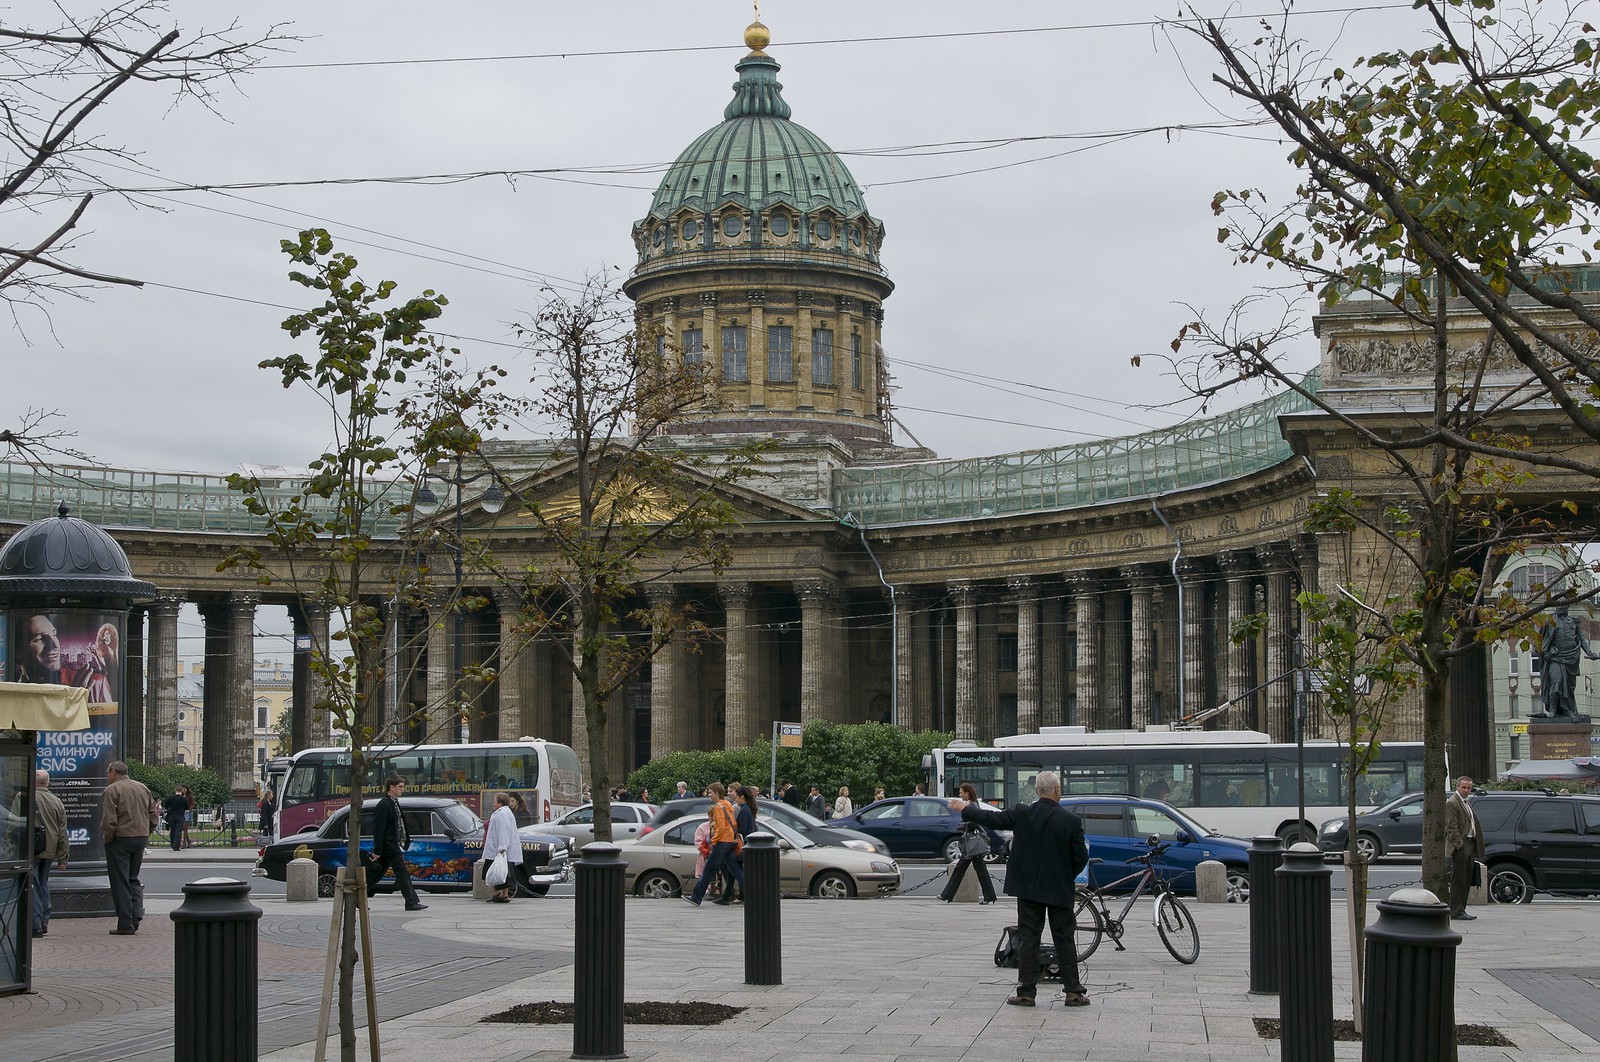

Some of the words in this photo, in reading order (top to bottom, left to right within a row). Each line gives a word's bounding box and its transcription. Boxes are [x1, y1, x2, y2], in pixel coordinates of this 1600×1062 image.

[45, 732, 113, 746] копеек
[36, 747, 52, 757] за
[55, 747, 100, 759] минуту
[41, 758, 77, 772] SMS
[955, 755, 1000, 764] Транс-Альфа
[422, 783, 460, 792] СРАВНИТЕ
[67, 828, 90, 841] LE2.
[464, 841, 483, 849] SOU
